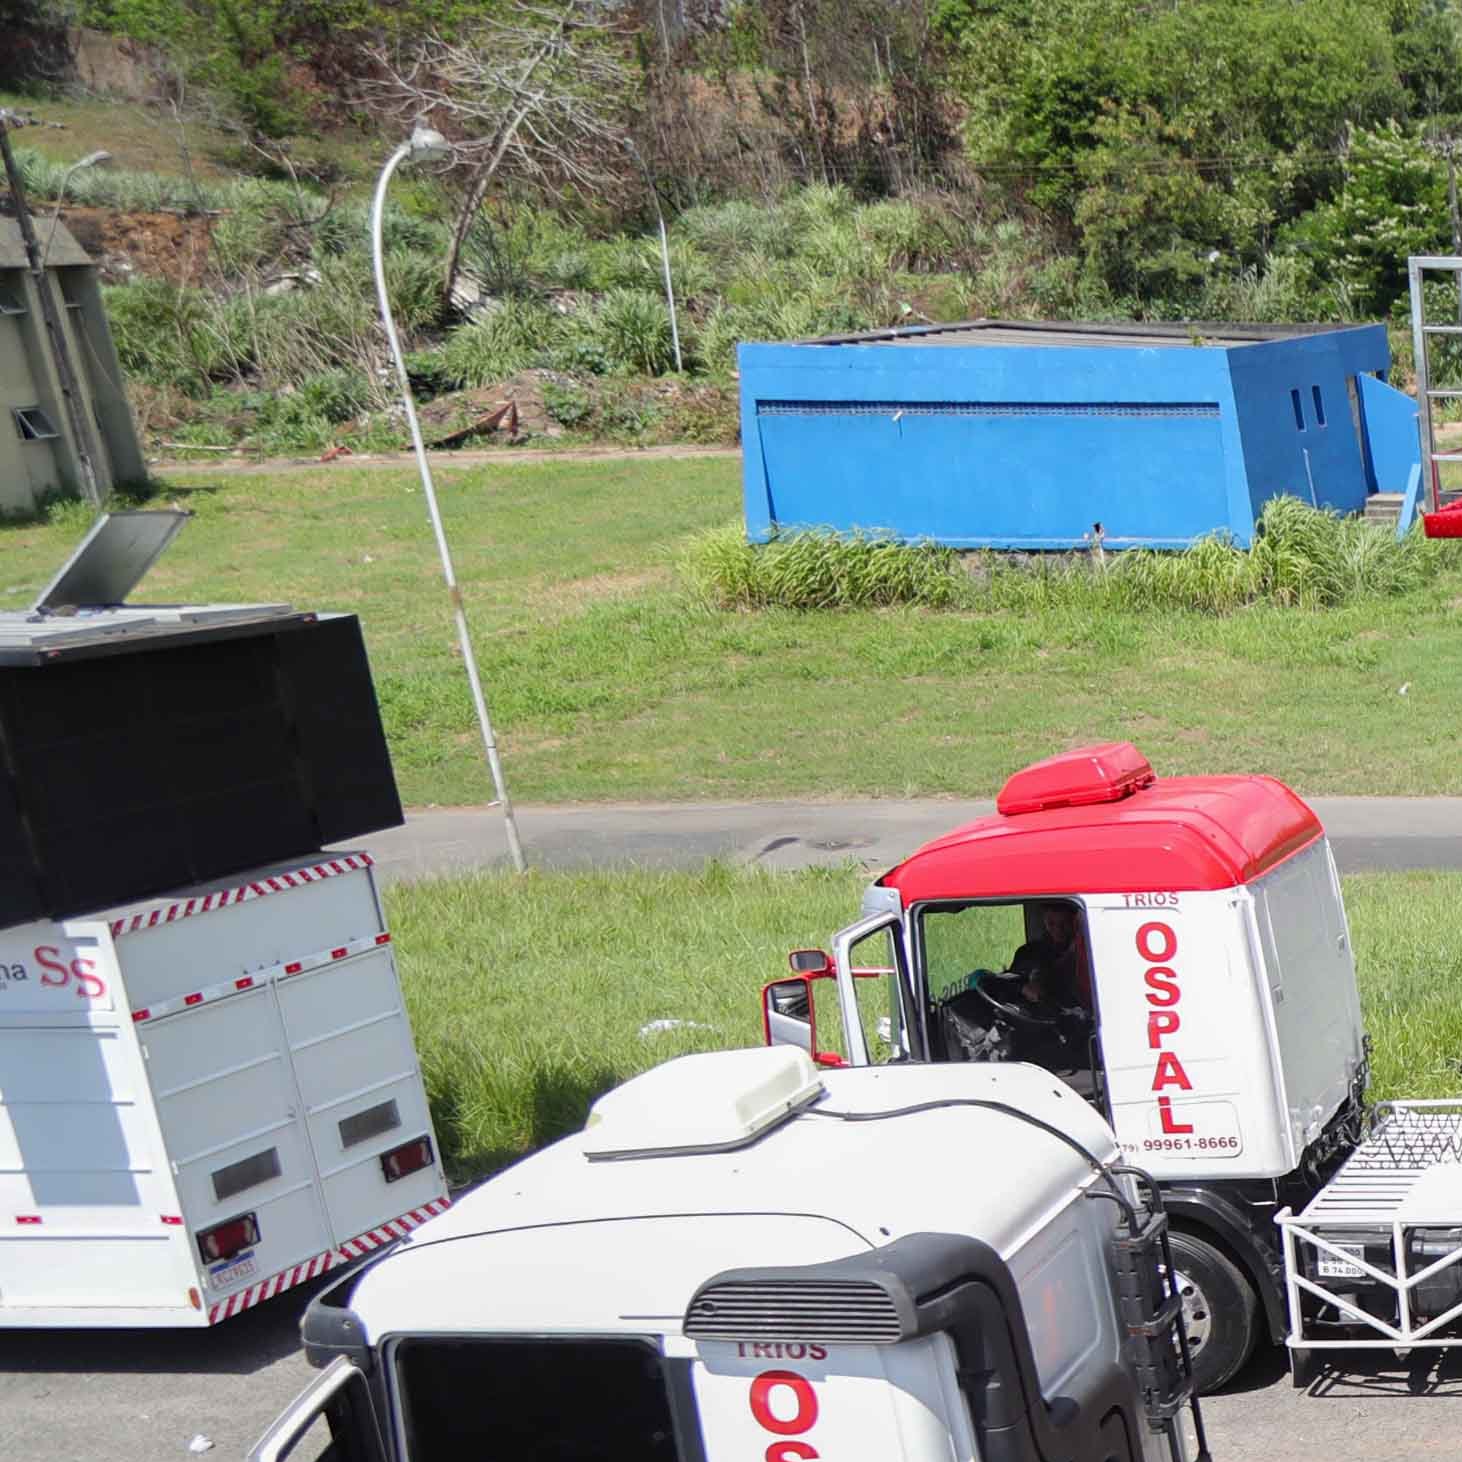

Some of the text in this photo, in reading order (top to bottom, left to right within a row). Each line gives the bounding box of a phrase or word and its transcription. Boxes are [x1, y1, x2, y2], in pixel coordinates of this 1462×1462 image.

[1121, 891, 1179, 908] TRIOS
[1135, 921, 1194, 1134] OSPAL
[1143, 1136, 1239, 1151] 99961-8666
[737, 1342, 829, 1360] TRIOS
